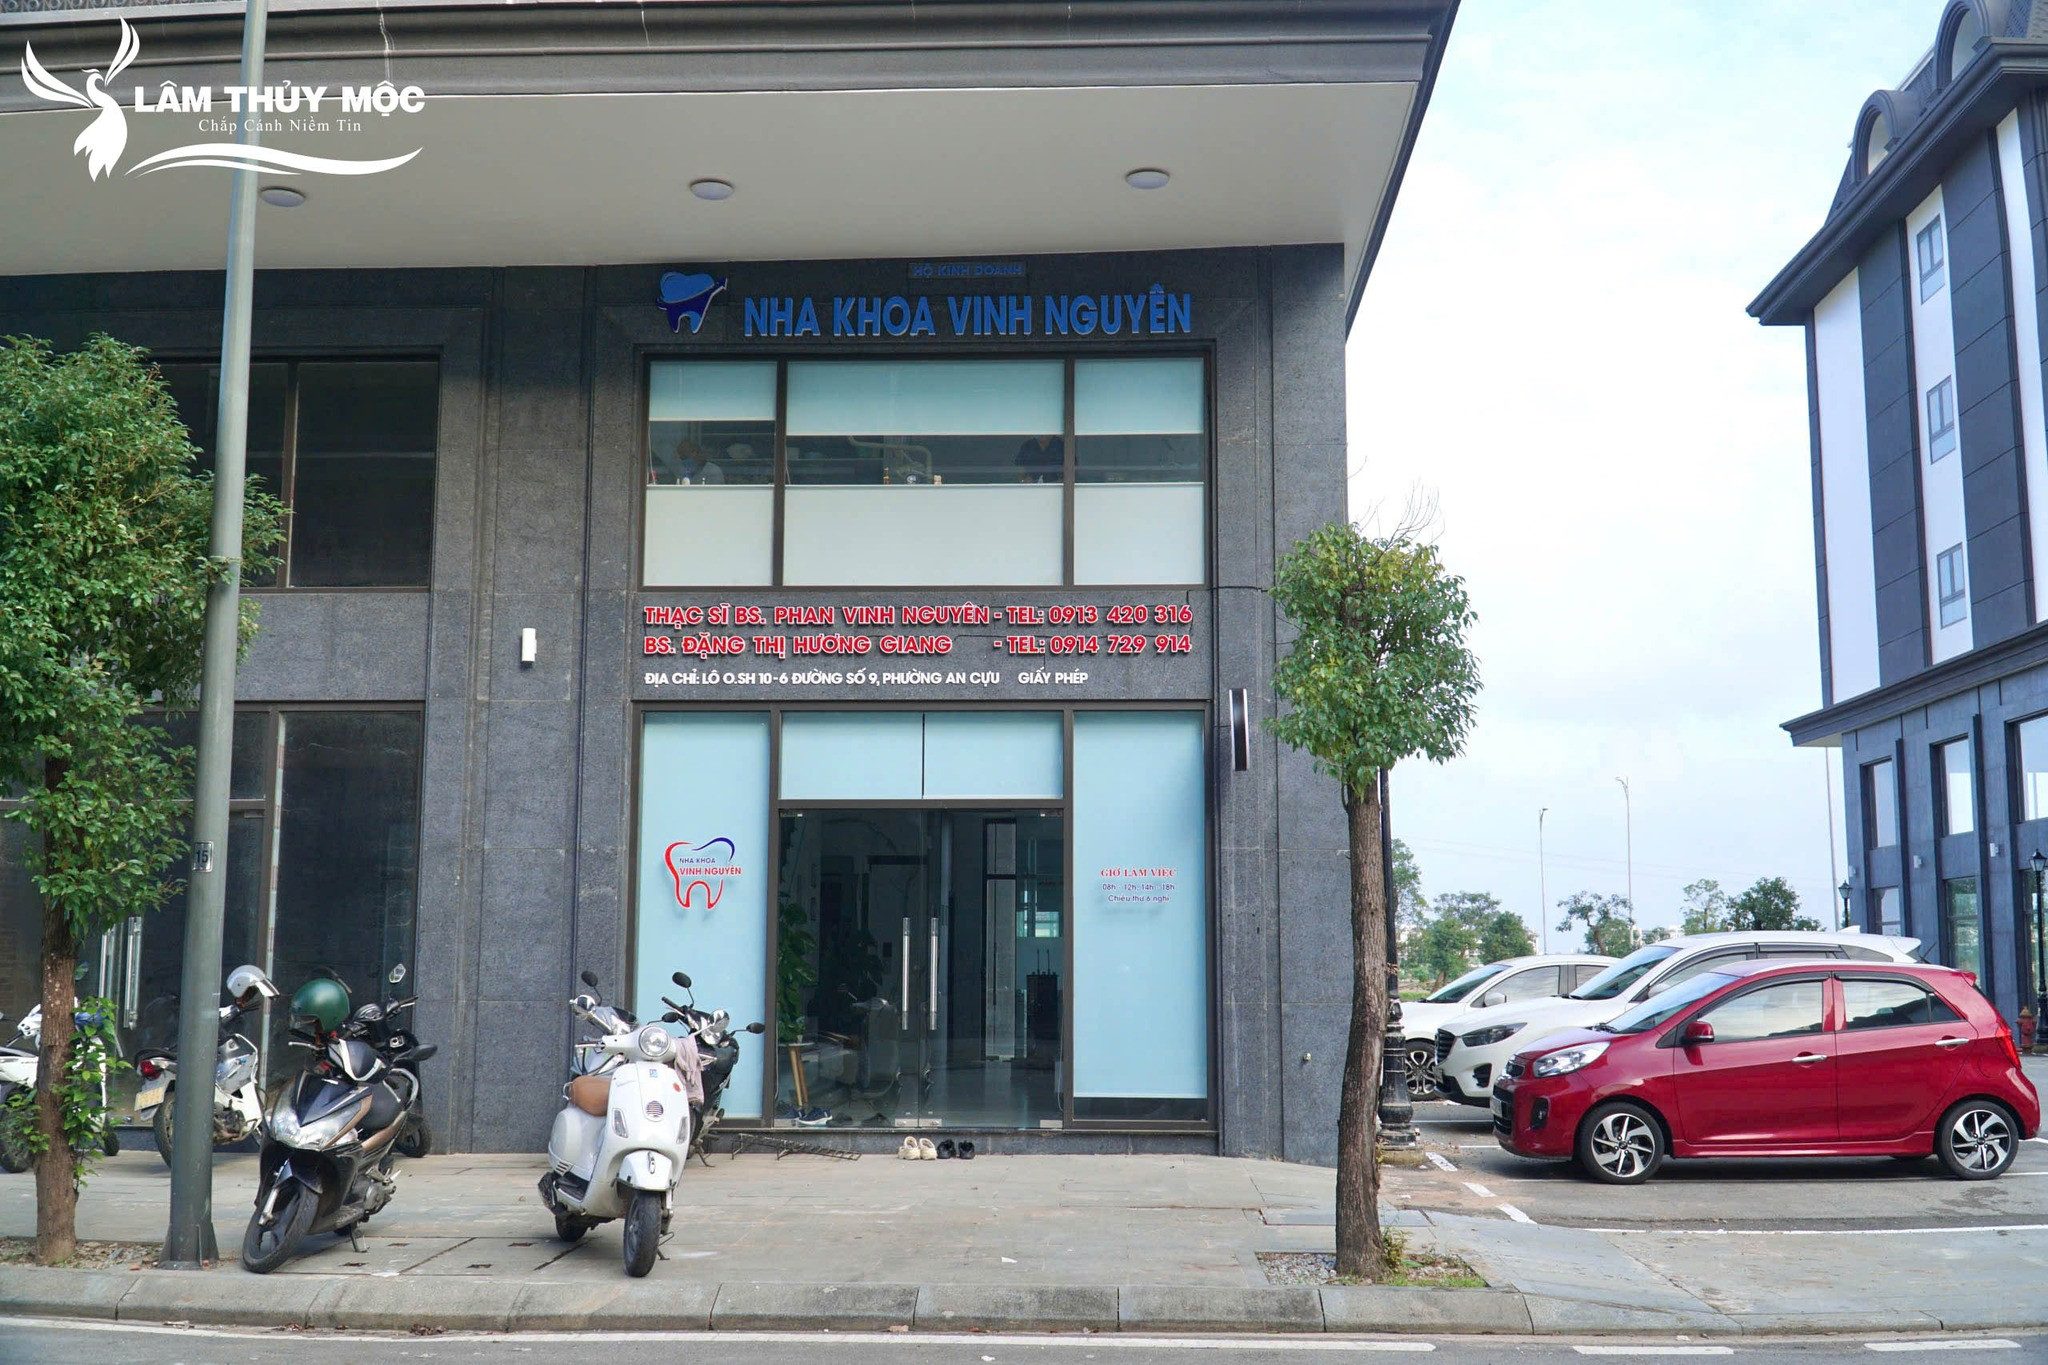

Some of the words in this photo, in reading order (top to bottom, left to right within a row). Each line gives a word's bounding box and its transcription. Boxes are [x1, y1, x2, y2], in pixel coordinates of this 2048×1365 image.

[744, 296, 821, 337] NHA
[833, 296, 936, 337] KHOA
[947, 295, 1033, 336] VINH
[1044, 281, 1193, 335] NGUYÊN
[644, 606, 704, 629] THẠC
[708, 603, 730, 625] SĨ
[734, 606, 766, 625] BS.
[774, 606, 834, 625] PHAN
[843, 606, 894, 625] VINH
[901, 602, 989, 625] NGUYÊN
[1006, 606, 1044, 624] TEL:
[1048, 605, 1098, 624] 0913
[1106, 605, 1148, 623] 420
[1154, 605, 1193, 623] 316
[644, 636, 676, 655] BS.
[682, 632, 744, 659] ĐẶNG
[753, 637, 786, 659] THỊ
[793, 634, 871, 655] HƯƠNG
[879, 636, 952, 655] GIANG
[1006, 636, 1046, 654] TEL:
[1049, 636, 1099, 654] 0914
[1107, 636, 1146, 653] 729
[1154, 635, 1191, 653] 914
[644, 672, 669, 688] ĐỊA
[671, 669, 700, 684] CHỈ:
[702, 669, 719, 684] LÔ
[722, 671, 756, 684] O.SH
[759, 671, 789, 684] 10-6
[791, 667, 842, 685] ĐƯỜNG
[846, 667, 867, 684] SỐ
[868, 671, 881, 686] 9,
[882, 668, 942, 684] PHƯỜNG
[945, 672, 966, 684] AN
[969, 672, 1000, 687] CỰU
[1018, 667, 1051, 684] GIẤY
[1055, 669, 1089, 684] PHÉP
[679, 867, 702, 875] VINH
